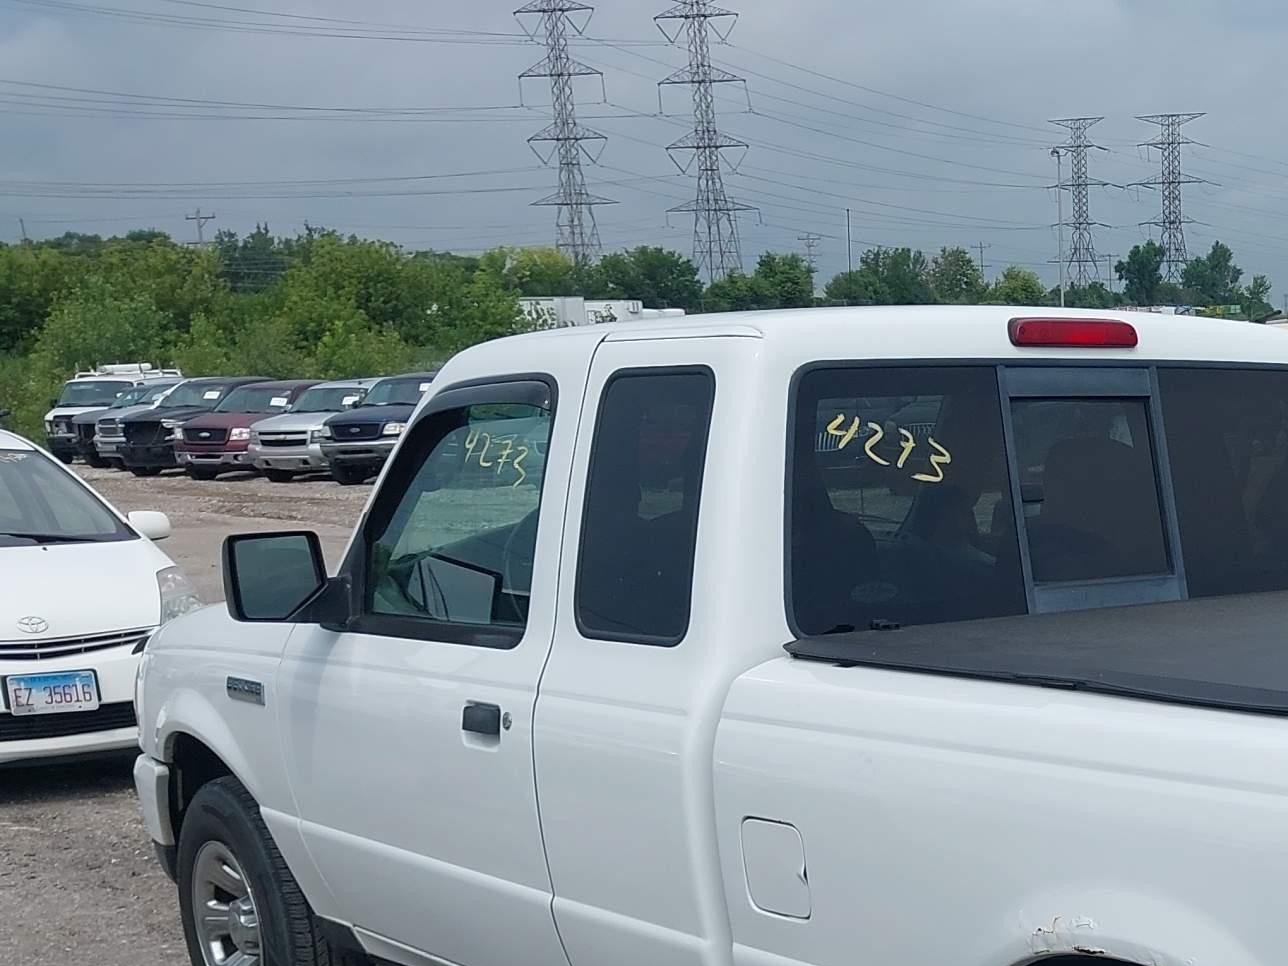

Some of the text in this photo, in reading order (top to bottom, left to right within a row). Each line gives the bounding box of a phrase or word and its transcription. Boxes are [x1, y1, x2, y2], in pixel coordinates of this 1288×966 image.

[464, 430, 529, 489] 4273
[826, 413, 951, 482] 4273
[13, 683, 92, 707] EZ 35616
